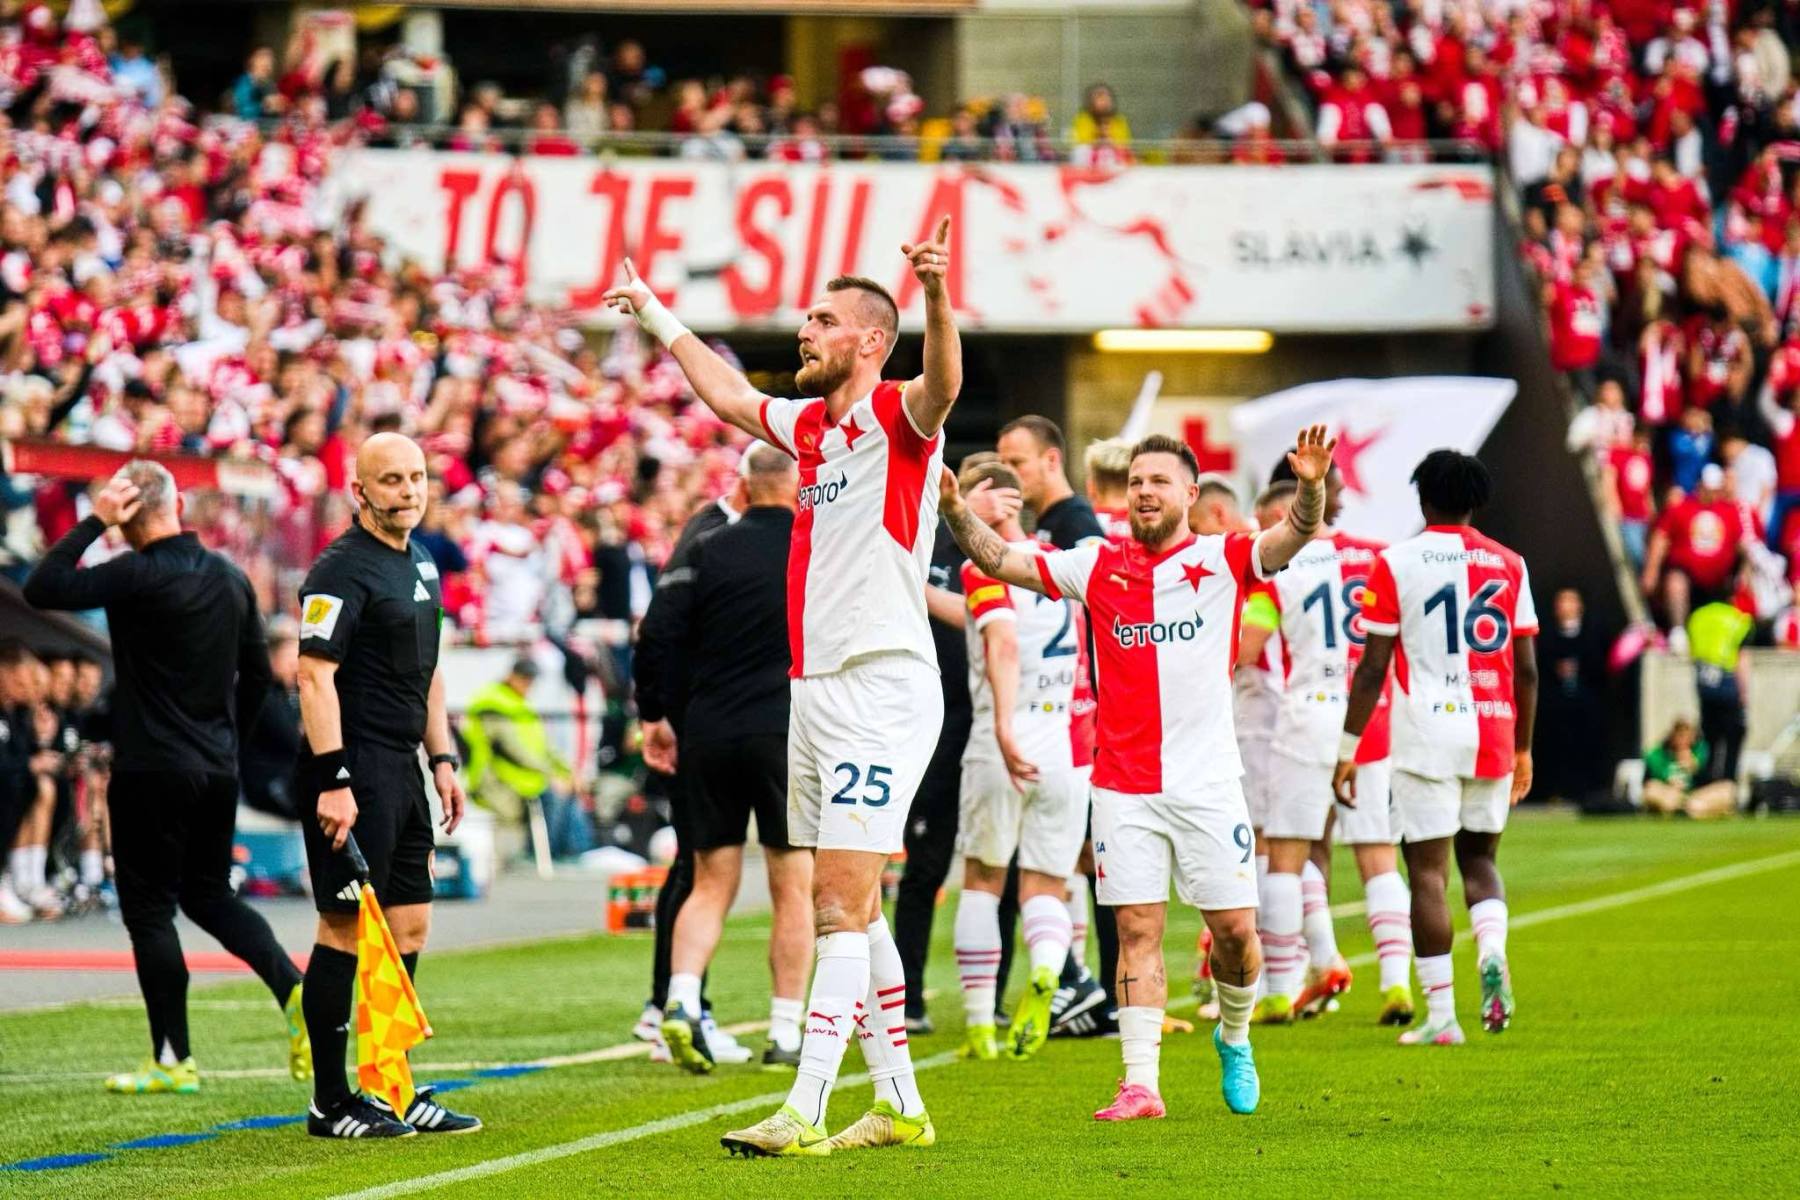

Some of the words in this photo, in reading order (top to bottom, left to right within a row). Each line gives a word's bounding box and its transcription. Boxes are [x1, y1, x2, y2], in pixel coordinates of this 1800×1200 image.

[1303, 574, 1367, 649] 18
[1423, 579, 1511, 655] 16
[831, 761, 894, 808] 25
[1233, 822, 1252, 864] 9
